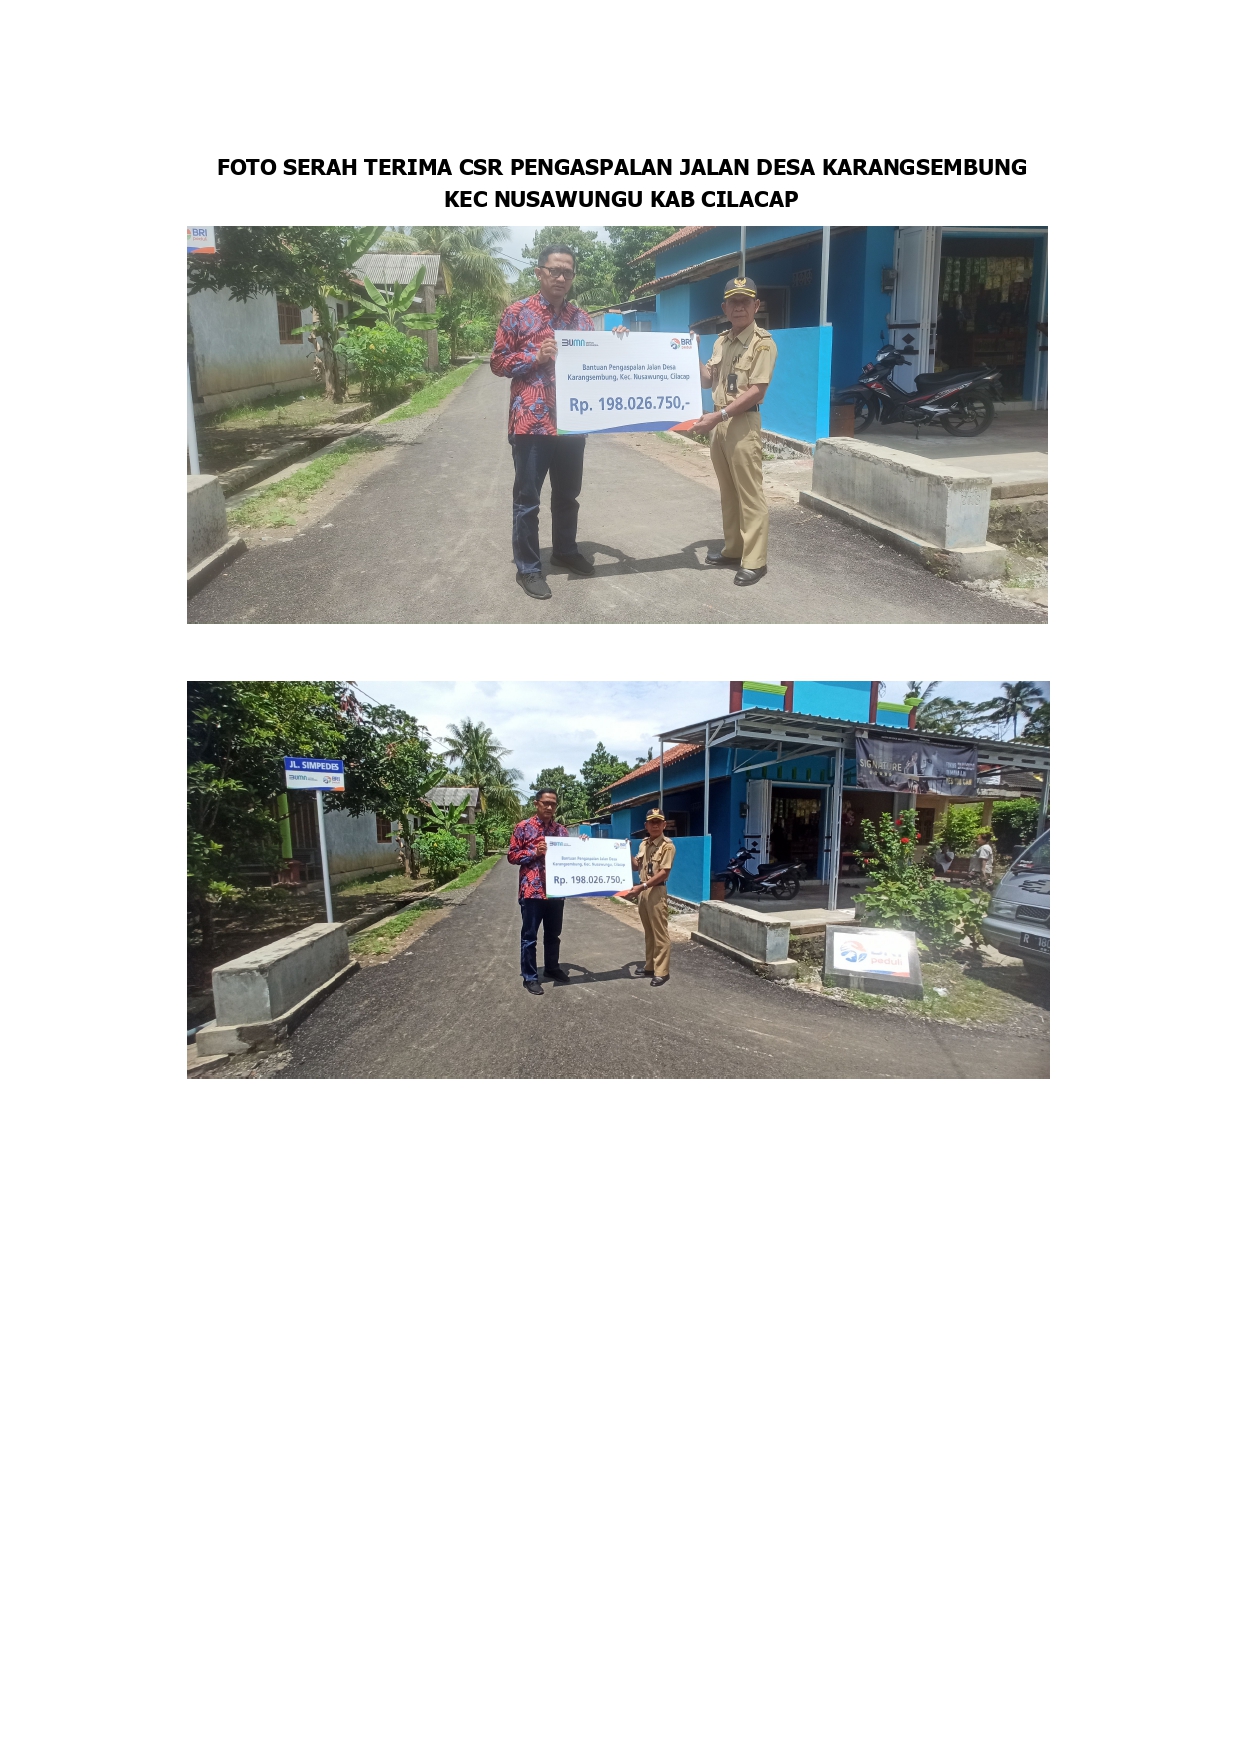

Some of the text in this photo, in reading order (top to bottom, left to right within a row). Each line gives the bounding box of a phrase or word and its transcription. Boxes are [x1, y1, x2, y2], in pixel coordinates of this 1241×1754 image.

[192, 229, 208, 237] BRI
[582, 363, 677, 372] Bantuan Pengaspalan Jalan Desa
[567, 372, 690, 382] Karangsembung, Kec. Nusawungu, Cilacap
[569, 395, 690, 415] Rp. 198.026.750,-
[302, 762, 339, 770] SIMPEDES
[860, 758, 902, 772] SIGNATURE
[554, 876, 625, 886] Rp. 198.026.750,-
[1023, 933, 1030, 944] R
[871, 957, 903, 966] peduli
